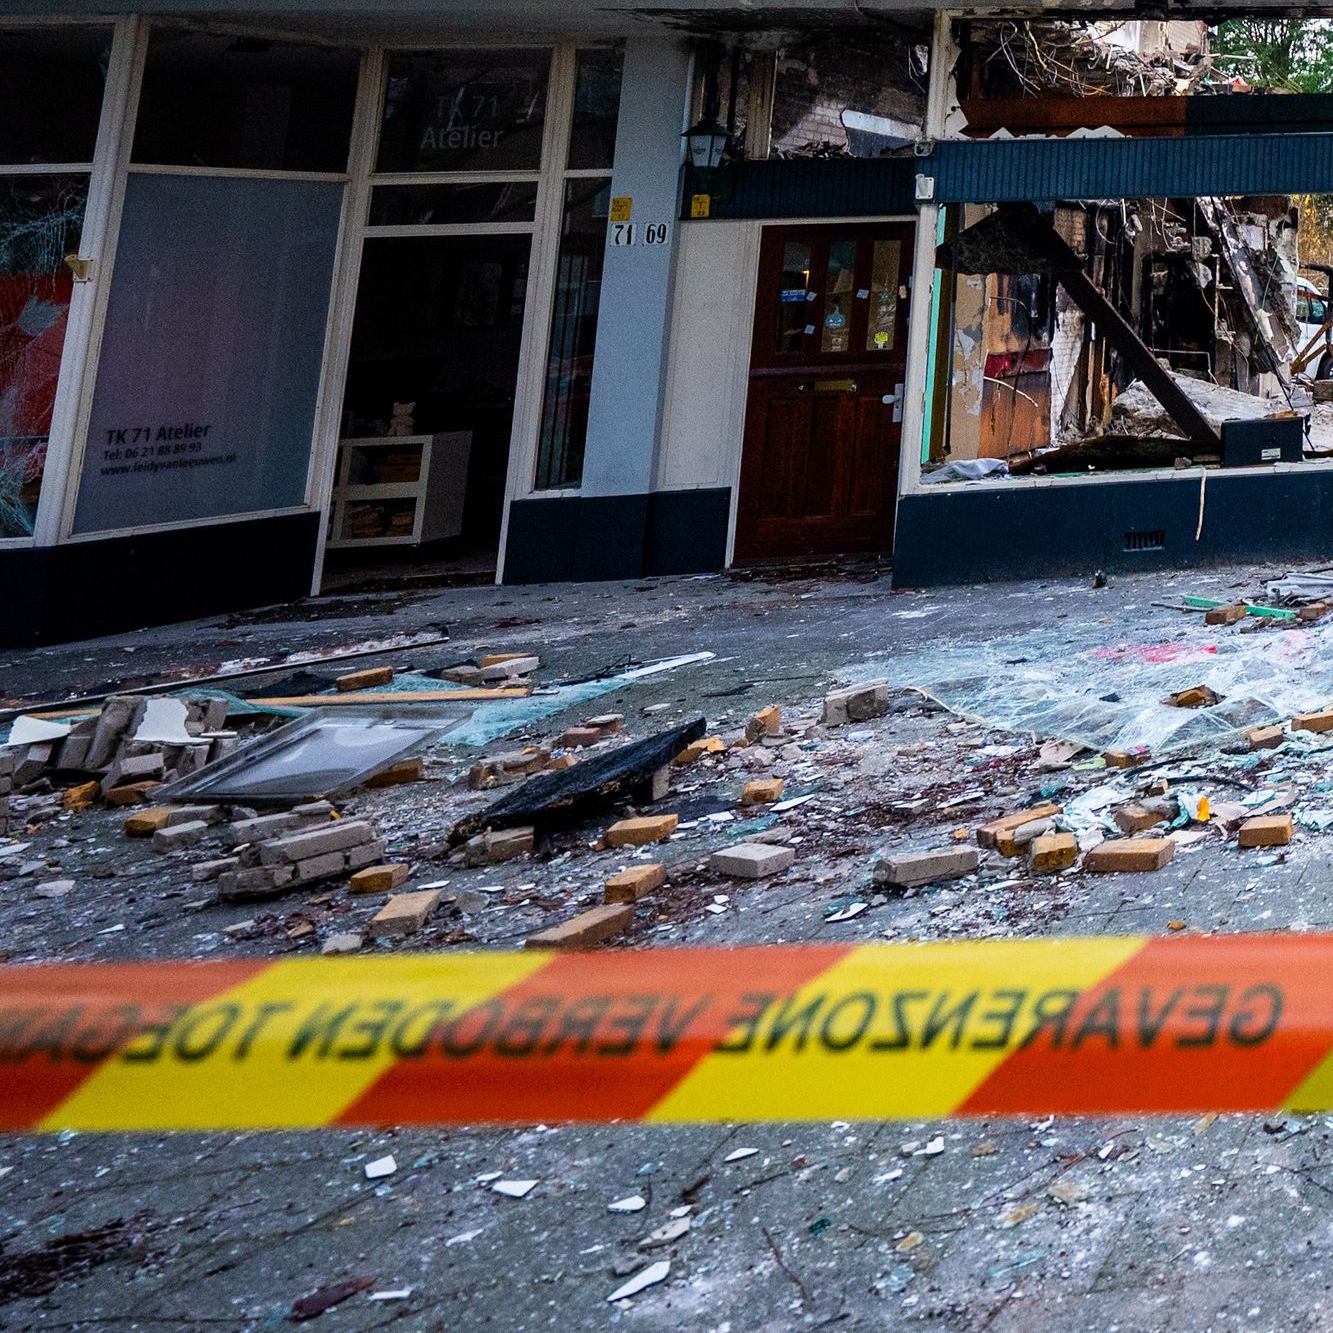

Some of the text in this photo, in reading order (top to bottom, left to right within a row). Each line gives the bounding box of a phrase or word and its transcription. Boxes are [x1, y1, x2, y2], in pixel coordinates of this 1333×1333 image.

[434, 95, 499, 120] TK 71
[419, 125, 504, 149] Atelier
[615, 224, 633, 245] 71
[646, 224, 667, 244] 69
[106, 423, 211, 446] TK 71 Atelier
[103, 449, 122, 461] Tel:
[125, 447, 139, 459] 06
[141, 445, 154, 458] 21
[158, 444, 171, 456] 88
[188, 442, 202, 453] 93
